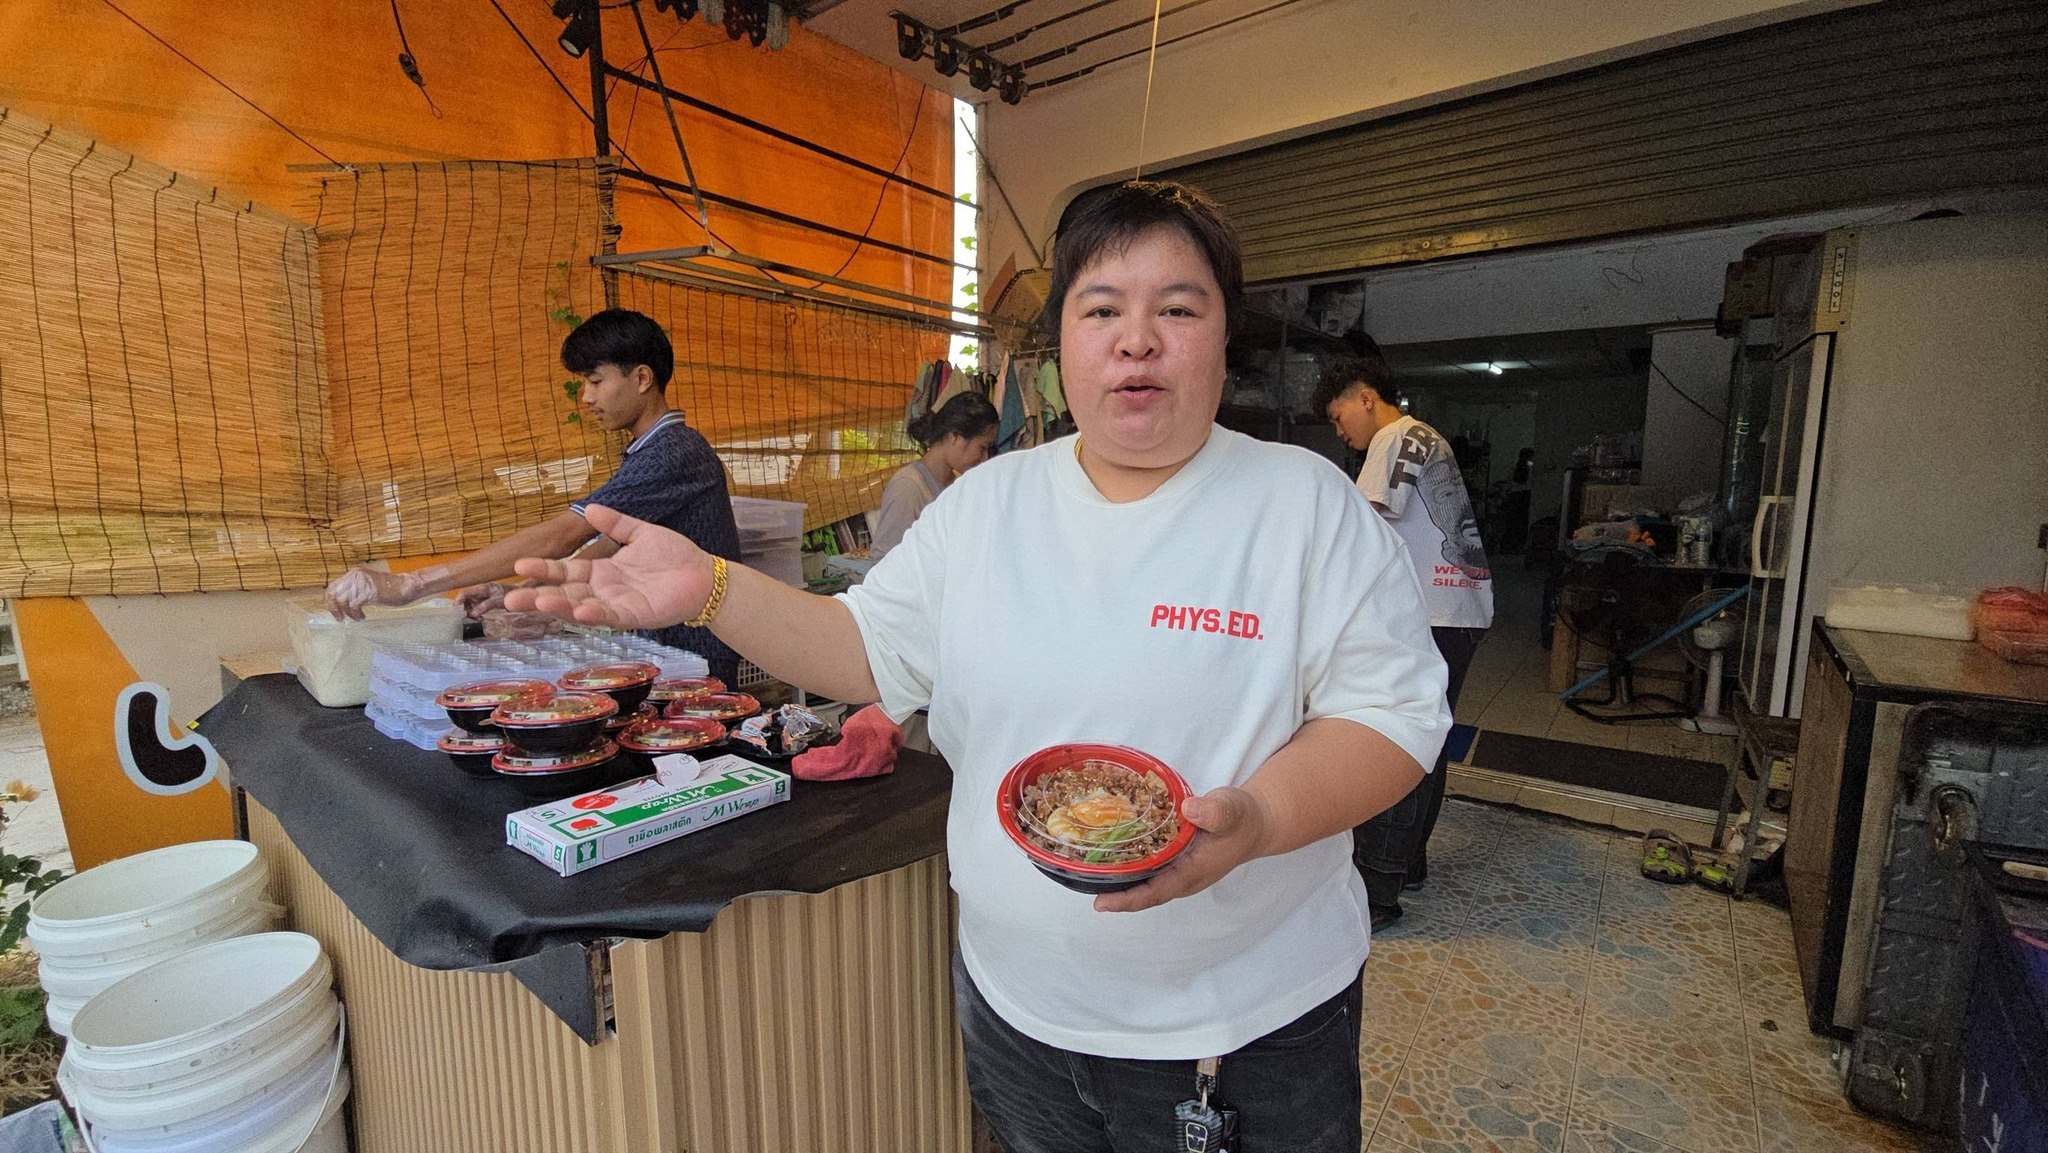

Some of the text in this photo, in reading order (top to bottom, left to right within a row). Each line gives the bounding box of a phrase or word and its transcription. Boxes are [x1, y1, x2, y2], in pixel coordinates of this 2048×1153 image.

[1434, 565, 1459, 575] WE
[1151, 604, 1264, 640] PHYS.ED.
[641, 795, 690, 810] Wrap
[727, 797, 760, 819] Wrap
[541, 810, 556, 820] S
[627, 815, 693, 848] ถุงมือพลาสติก
